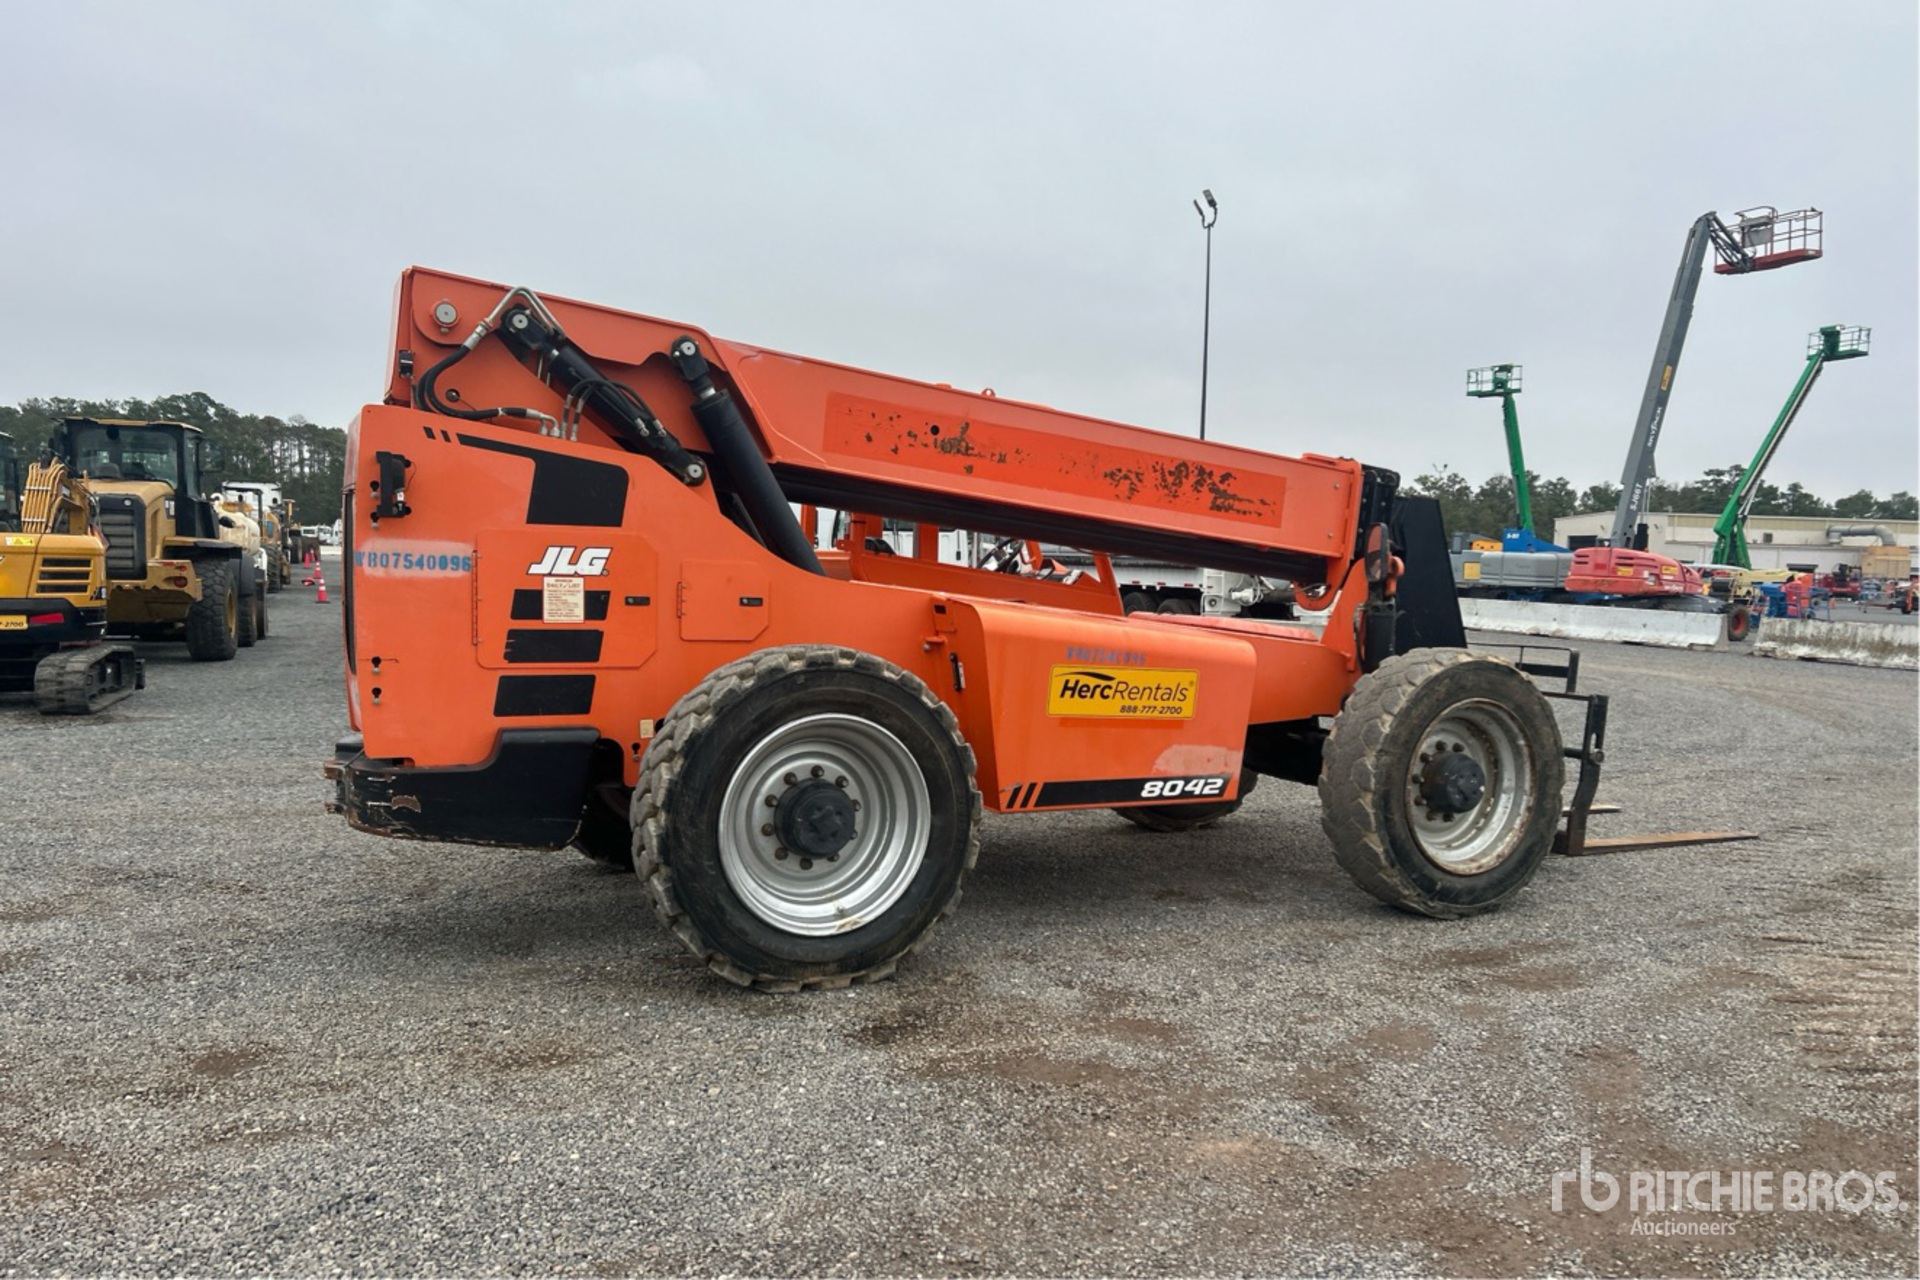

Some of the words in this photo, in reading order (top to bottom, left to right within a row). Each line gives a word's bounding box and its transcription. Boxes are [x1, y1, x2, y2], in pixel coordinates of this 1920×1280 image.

[526, 546, 613, 576] JLG
[1060, 679, 1188, 702] HercRentals
[1120, 705, 1183, 715] 888-777-2700
[1140, 778, 1224, 798] 8042
